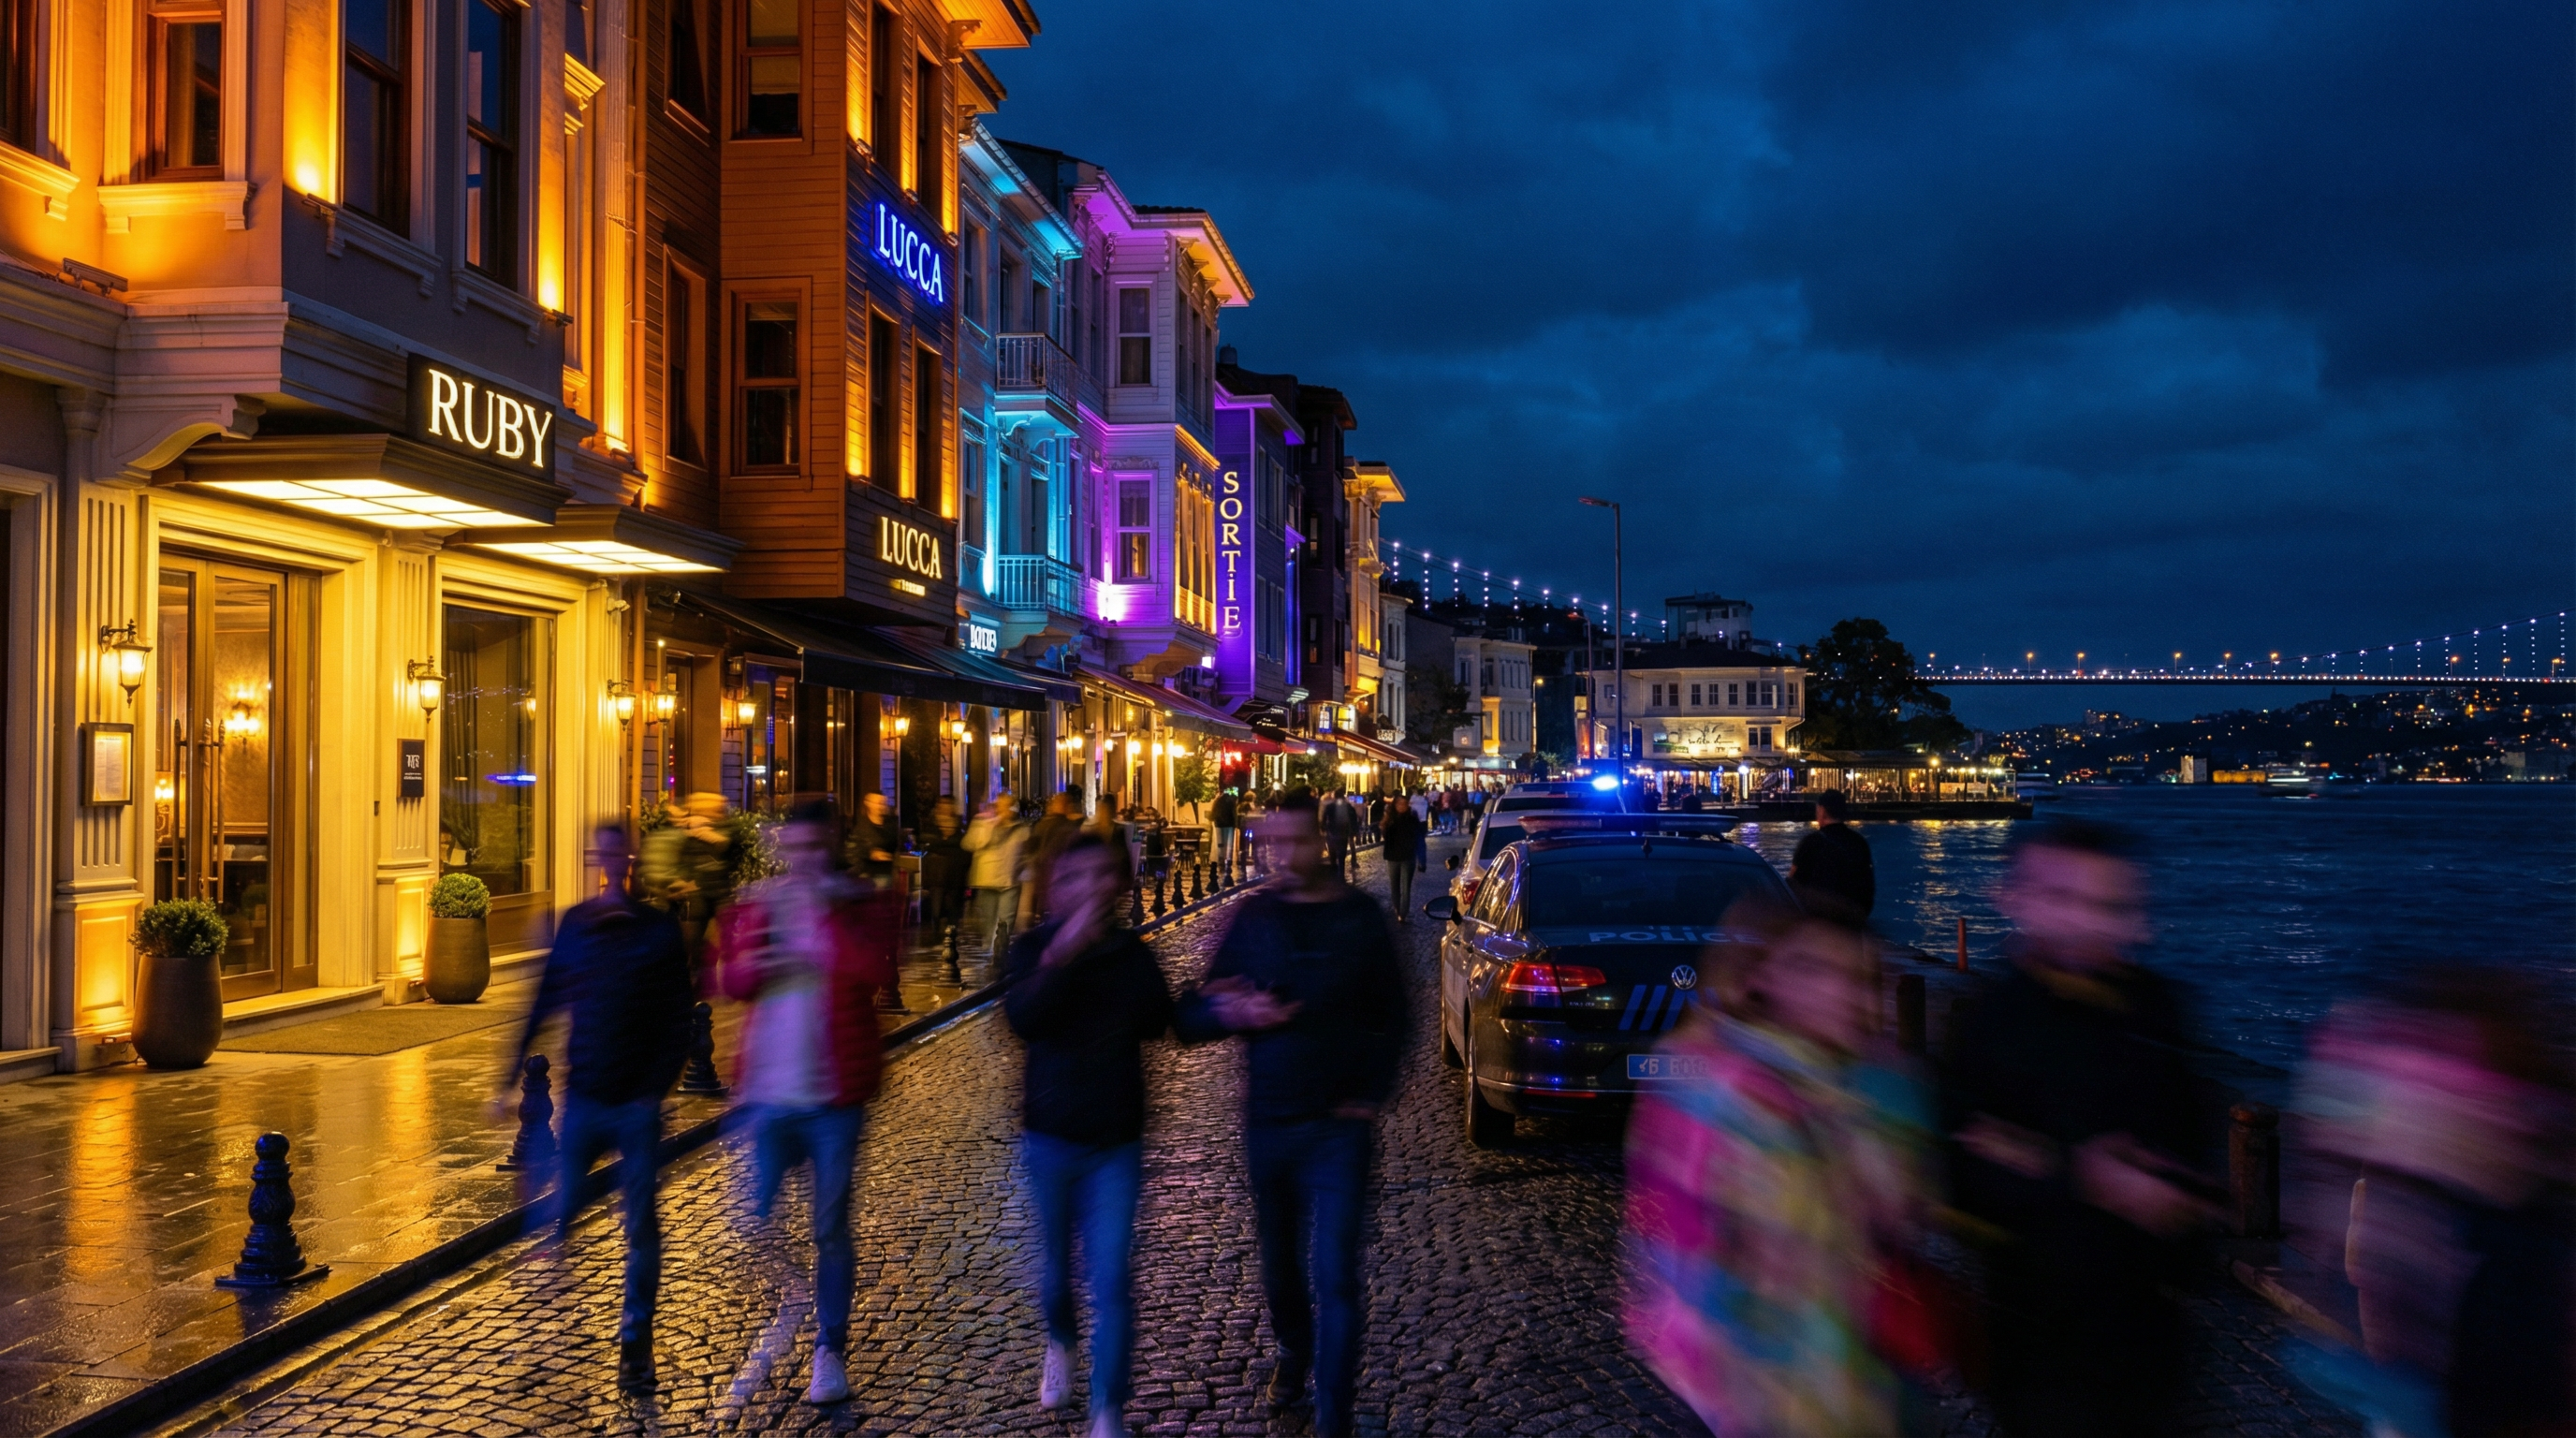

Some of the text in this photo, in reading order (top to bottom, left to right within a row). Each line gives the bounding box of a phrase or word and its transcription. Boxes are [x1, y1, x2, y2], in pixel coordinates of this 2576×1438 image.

[879, 203, 944, 302] LUCCA
[428, 368, 552, 468] RUBY
[881, 516, 943, 580] LUCCA
